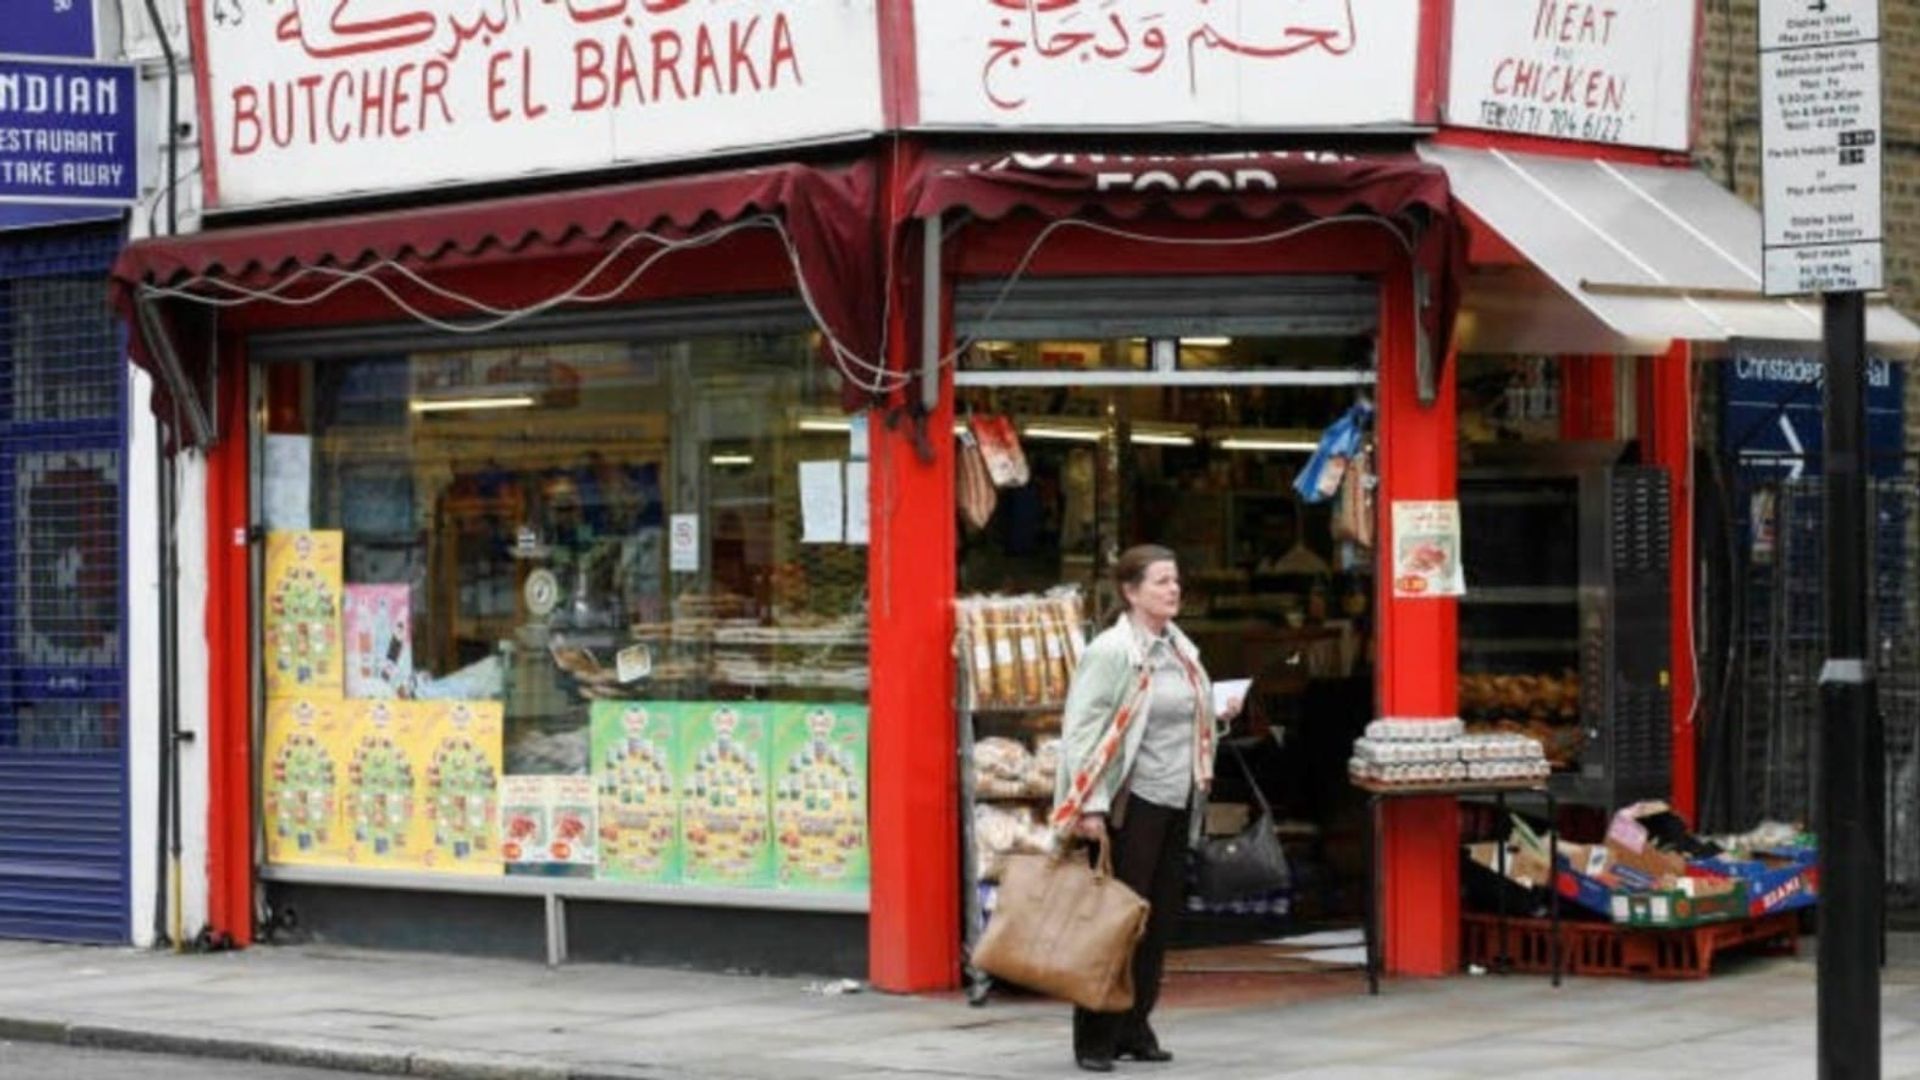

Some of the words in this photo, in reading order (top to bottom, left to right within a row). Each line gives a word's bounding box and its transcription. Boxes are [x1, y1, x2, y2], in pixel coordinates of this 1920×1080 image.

[1533, 0, 1617, 44] MEAT
[231, 60, 454, 155] BUTCHER
[488, 48, 547, 122] EL
[571, 12, 803, 111] BARAKA
[1493, 57, 1627, 112] CHICKEN
[4, 161, 56, 185] TAKE
[62, 164, 124, 186] AWAY
